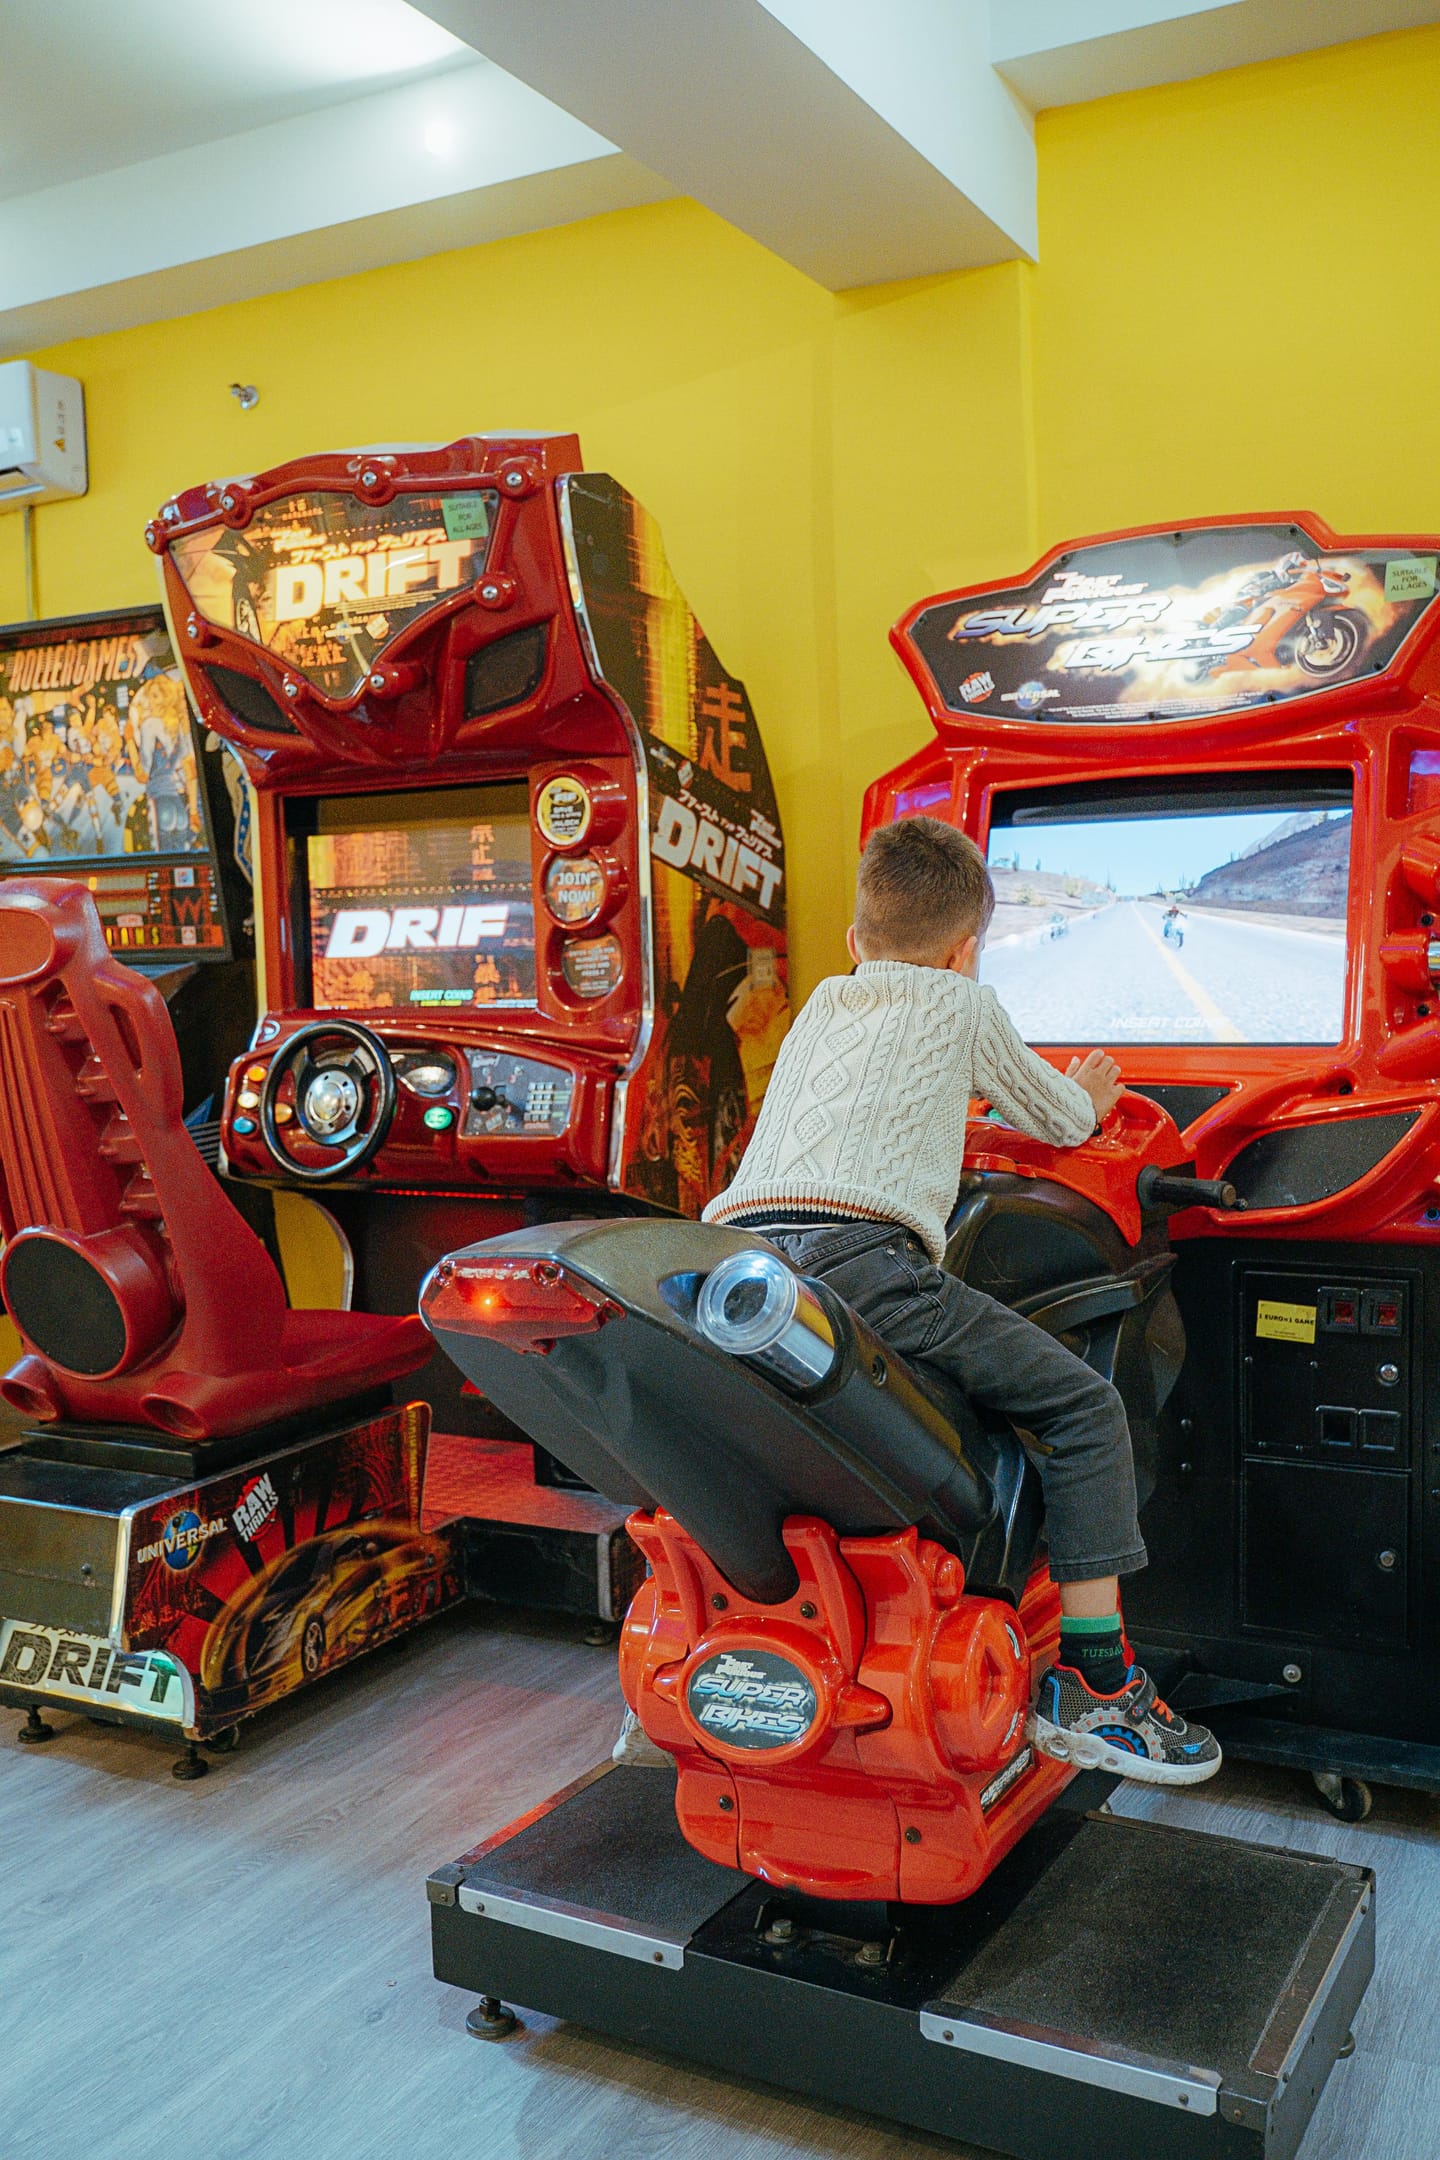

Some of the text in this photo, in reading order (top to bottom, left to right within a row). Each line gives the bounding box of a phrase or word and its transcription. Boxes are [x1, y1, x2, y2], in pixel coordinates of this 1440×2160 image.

[275, 539, 471, 622] DRIFT
[1390, 580, 1428, 592] ALL AGES
[954, 596, 1173, 638] SUPER
[8, 635, 141, 693] ROLLERGAMES
[1065, 624, 1264, 672] BIKES
[959, 671, 996, 697] RAW
[651, 795, 783, 909] DRIFT
[557, 872, 591, 886] JOIN
[557, 890, 596, 903] NOW!
[325, 904, 509, 958] DRIF
[1111, 1017, 1170, 1028] INSERT
[232, 1472, 274, 1531] RAW
[240, 1491, 279, 1542] THRILLS
[137, 1518, 228, 1564] UNIVERSAL
[0, 1630, 180, 1704] DRIFT
[694, 1676, 807, 1707] SUPER
[702, 1704, 805, 1734] BIKES
